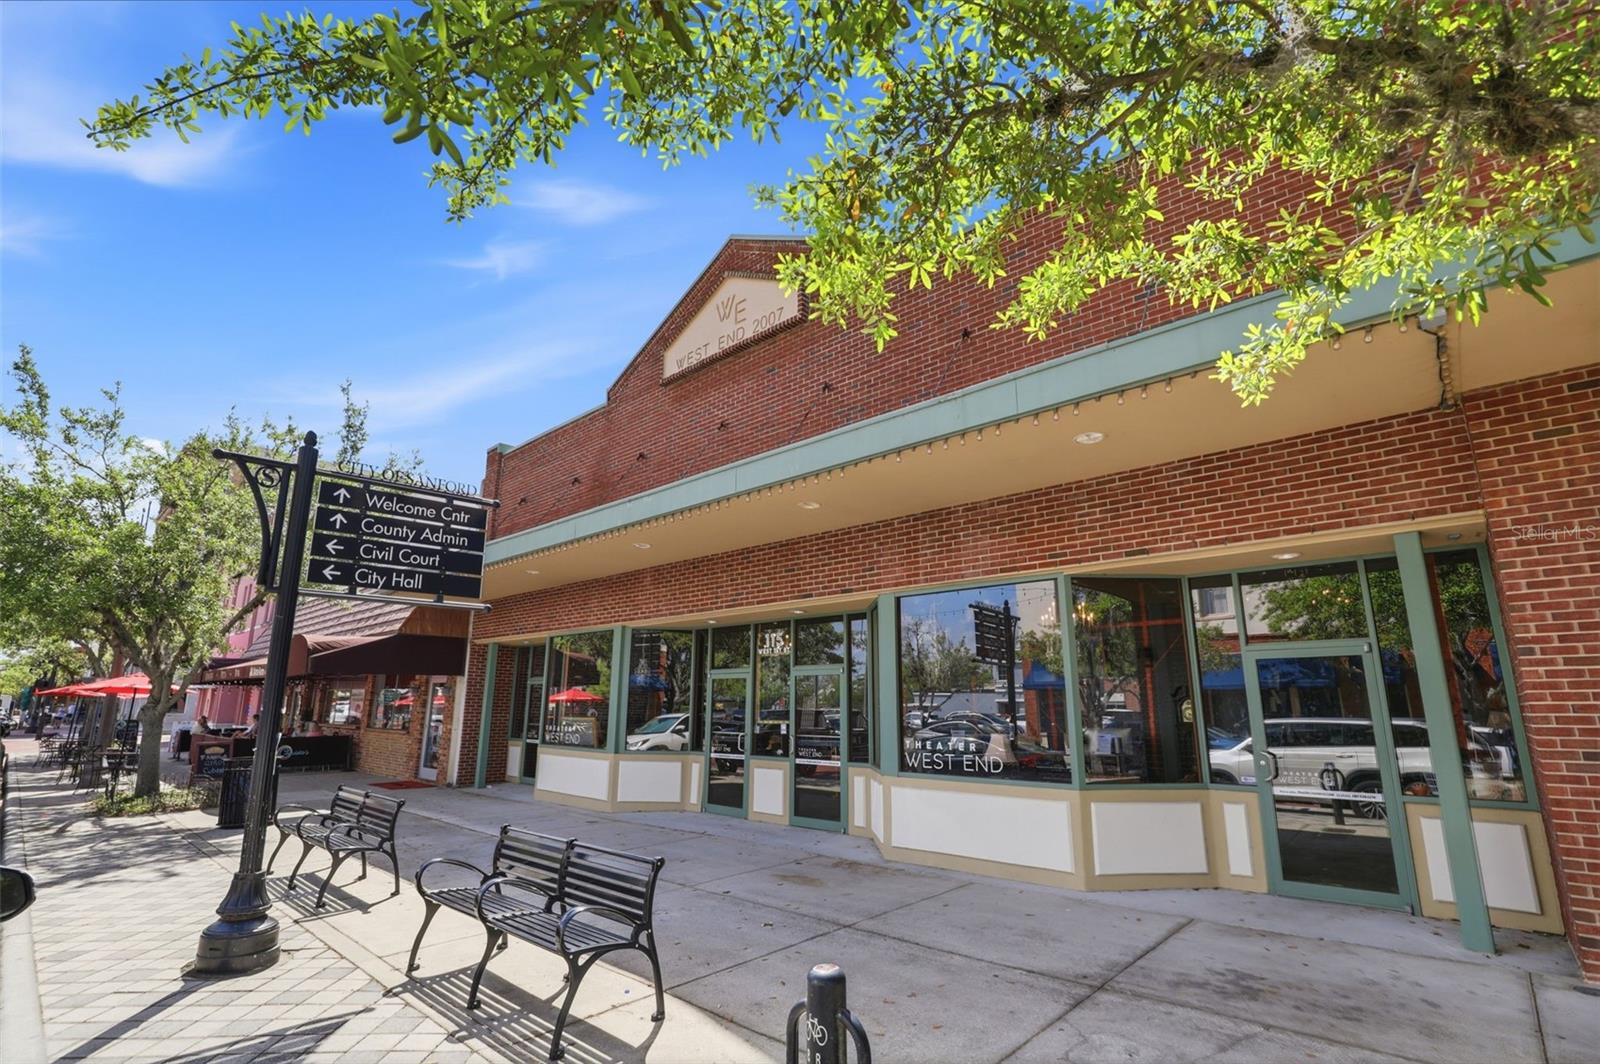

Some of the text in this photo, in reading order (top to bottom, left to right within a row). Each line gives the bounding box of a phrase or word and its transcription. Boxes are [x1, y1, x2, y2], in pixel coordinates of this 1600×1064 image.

[675, 306, 784, 370] WEST END 2007
[338, 460, 478, 496] CITY OF SANFORD
[366, 493, 471, 523] Welcome Cntr
[361, 518, 468, 546] County Admin
[359, 544, 440, 567] Civil Court
[354, 568, 423, 590] City Hall
[905, 740, 976, 751] THEATER
[905, 752, 1004, 773] WEST END
[1280, 776, 1307, 785] WEST
